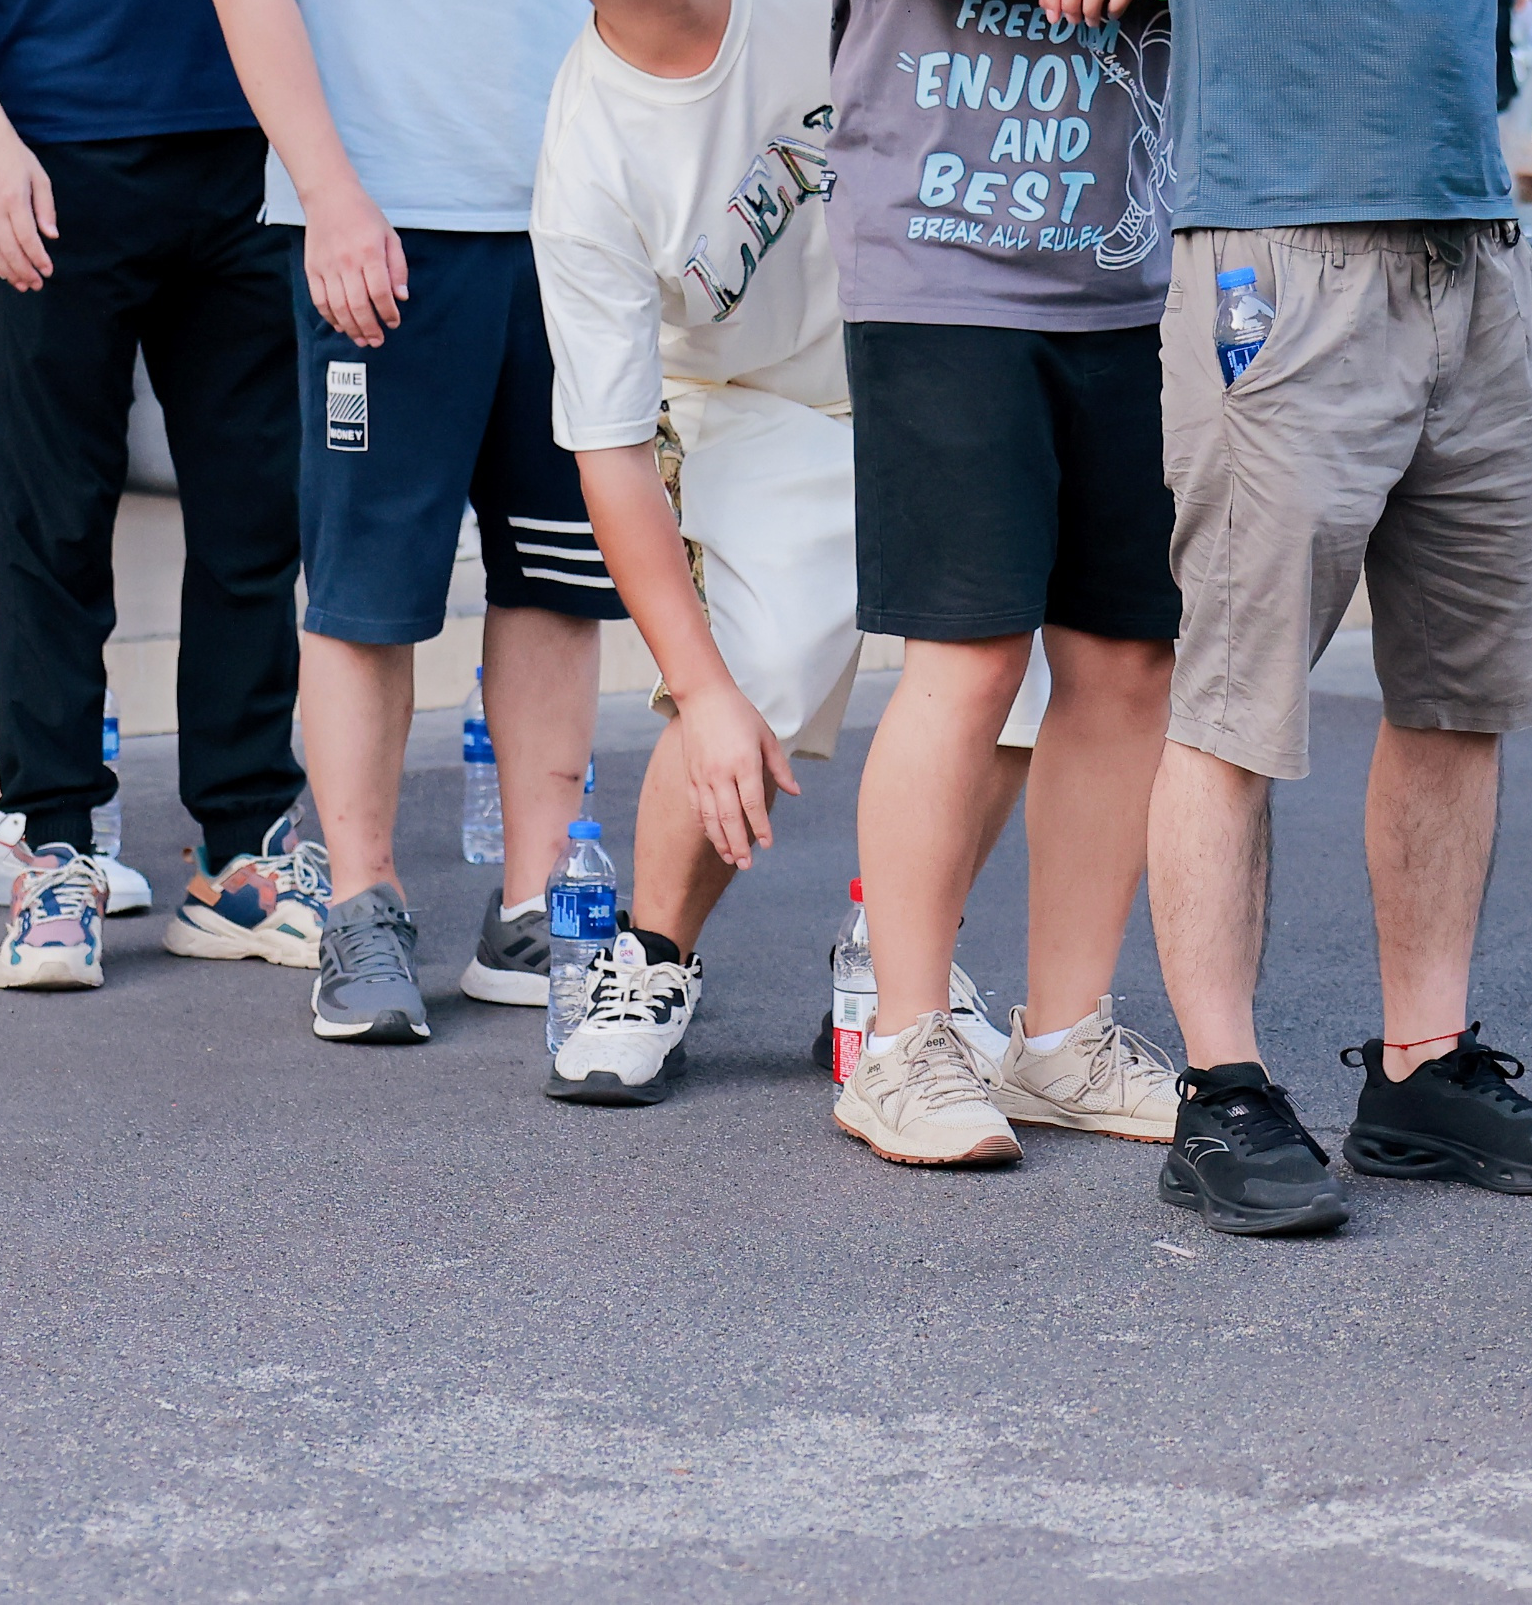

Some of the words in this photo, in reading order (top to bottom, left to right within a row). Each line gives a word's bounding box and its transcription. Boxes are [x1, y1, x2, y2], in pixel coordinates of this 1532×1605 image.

[915, 50, 1102, 114] ENJOY
[989, 115, 1092, 164] AND
[917, 151, 1098, 226] BEST
[907, 215, 985, 243] BREAK
[987, 223, 1032, 251] ALL
[1037, 223, 1106, 253] RULES
[331, 371, 363, 386] TIME
[330, 427, 364, 441] MONEY
